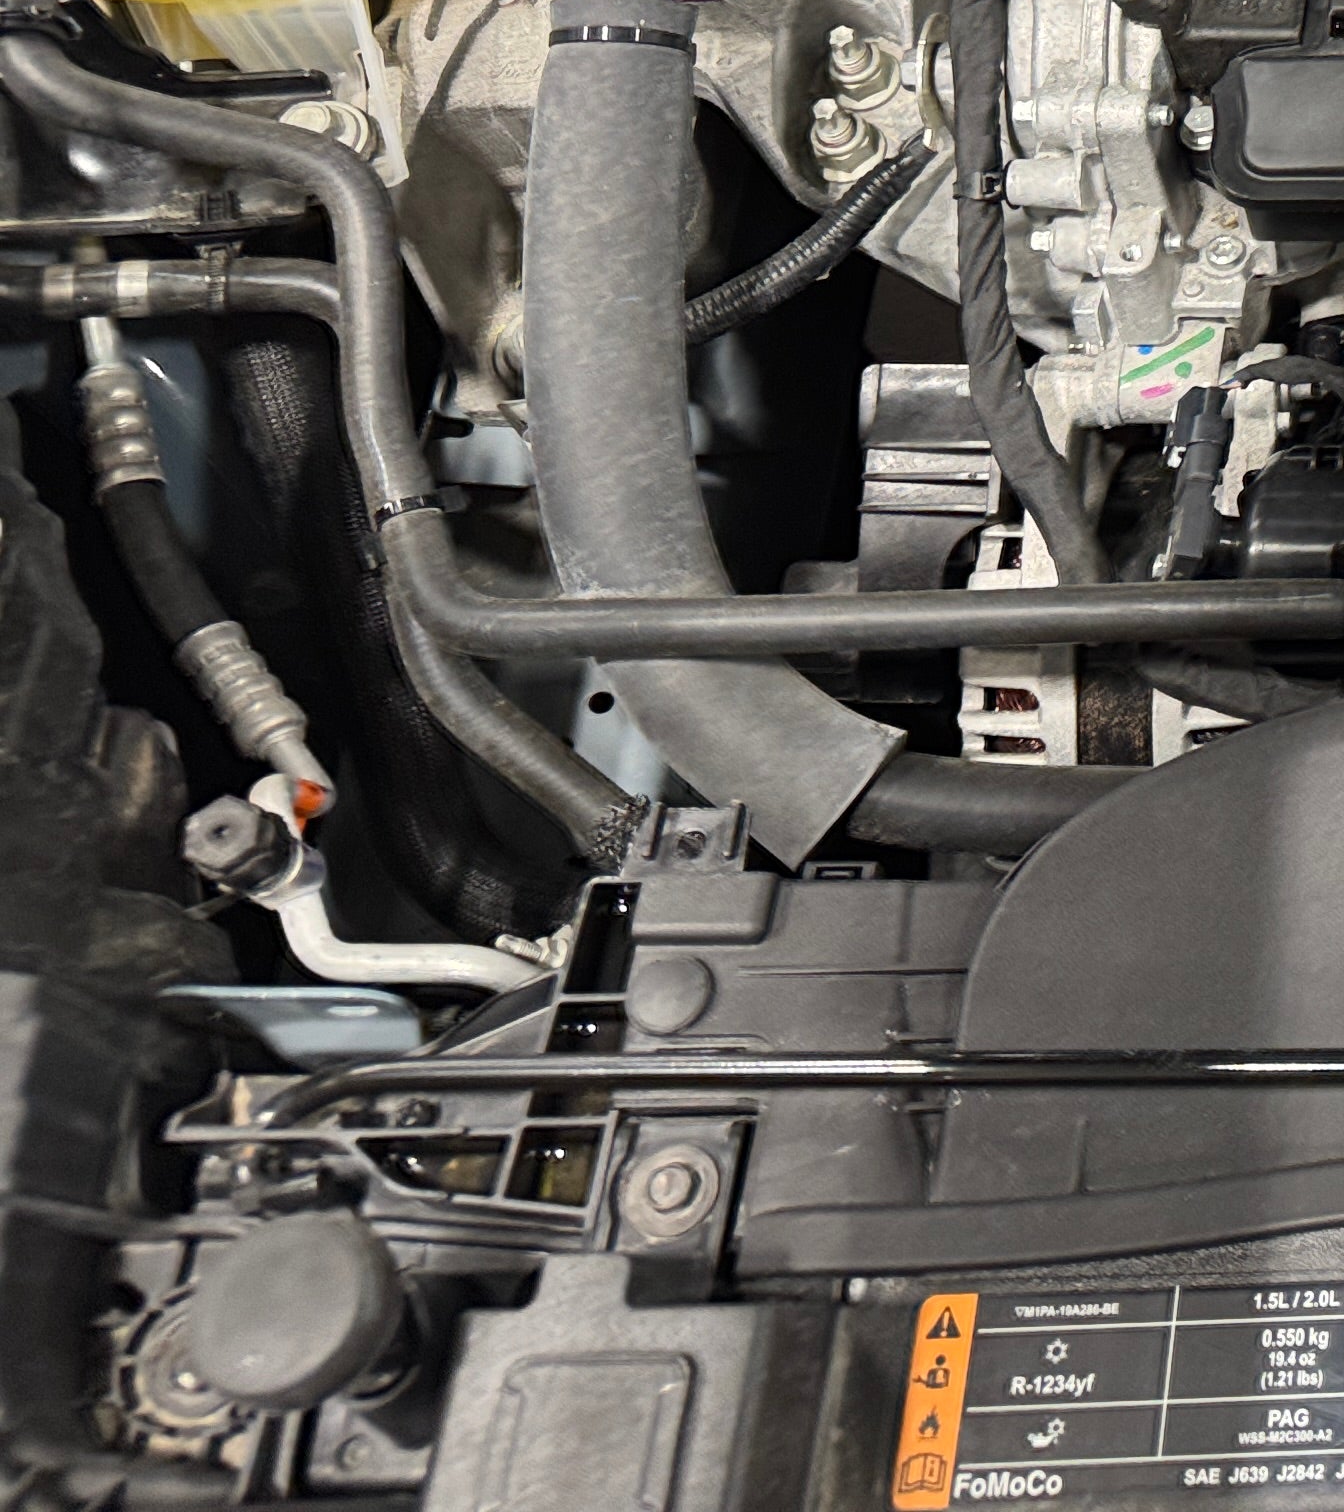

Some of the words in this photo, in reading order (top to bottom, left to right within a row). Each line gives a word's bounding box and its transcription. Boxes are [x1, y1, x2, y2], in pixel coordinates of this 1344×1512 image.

[1253, 1292, 1290, 1310] 1.5L
[1292, 1291, 1300, 1309] /
[1302, 1290, 1341, 1308] 2.0L
[1261, 1328, 1305, 1348] 0.550
[1308, 1327, 1330, 1350] kg
[1268, 1350, 1297, 1367] 19.4
[1298, 1353, 1316, 1366] oz
[1009, 1373, 1096, 1398] R-1234yf
[1260, 1371, 1293, 1391] (1.21
[1296, 1369, 1324, 1389] lbs)
[1267, 1408, 1310, 1428] PAG
[953, 1470, 1063, 1499] FoMoCo
[1183, 1467, 1221, 1486] SAE
[1228, 1465, 1269, 1484] J639
[1276, 1463, 1326, 1483] J2842
